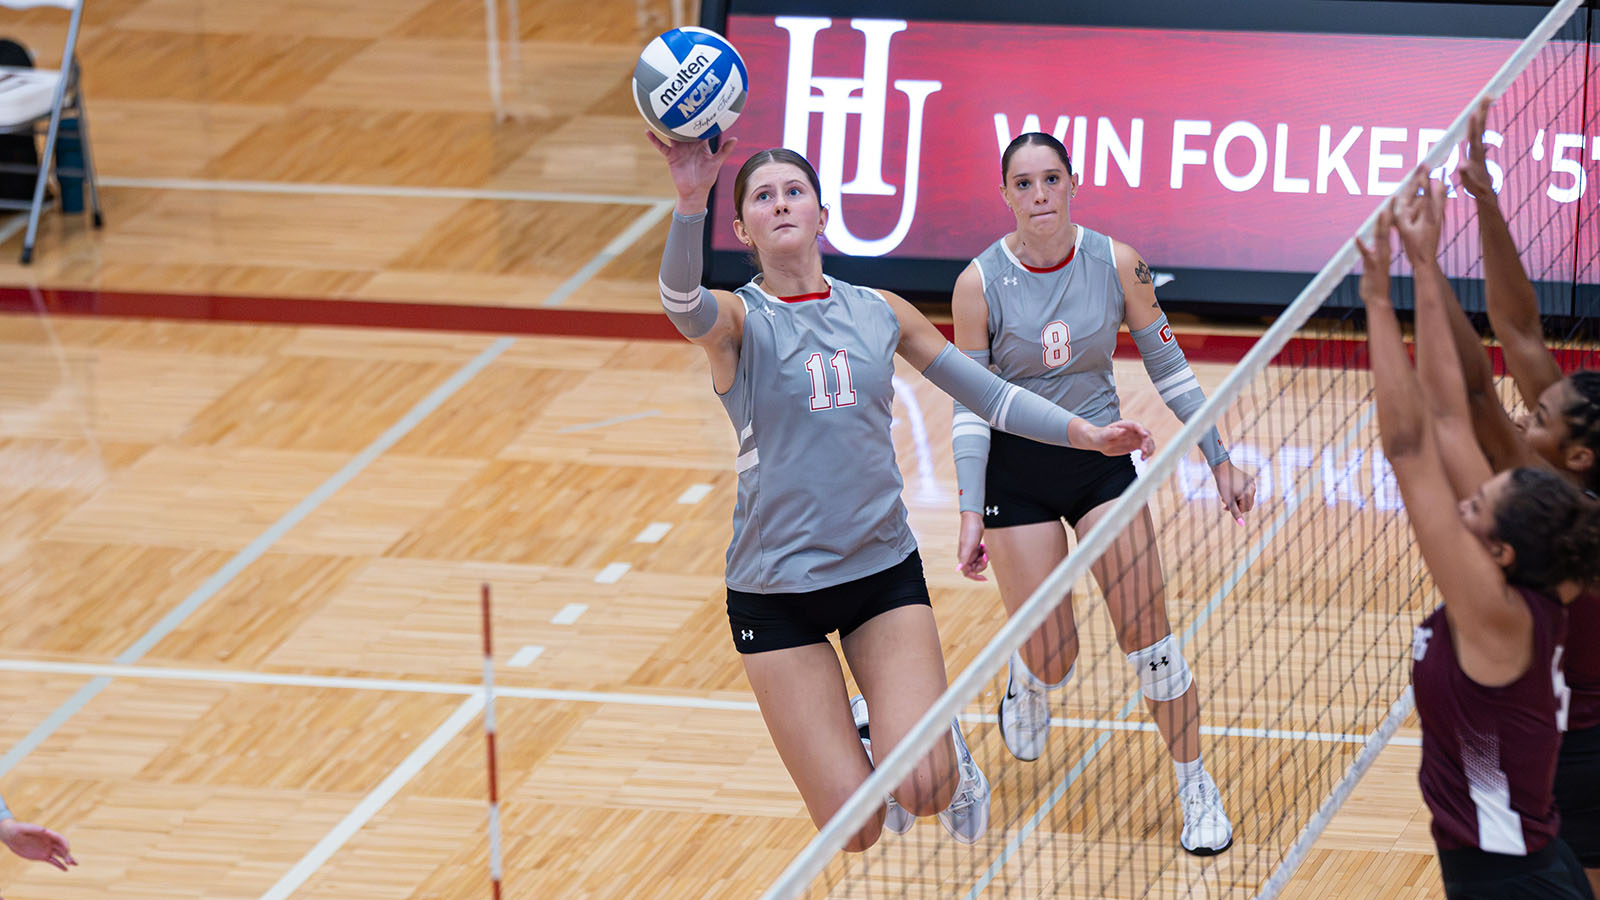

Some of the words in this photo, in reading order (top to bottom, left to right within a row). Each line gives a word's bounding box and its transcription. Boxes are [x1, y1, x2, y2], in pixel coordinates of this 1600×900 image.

[660, 54, 709, 107] molten
[677, 70, 721, 120] NCAA
[1531, 128, 1600, 204] ‘5
[1041, 319, 1072, 370] 8
[805, 348, 858, 412] 11
